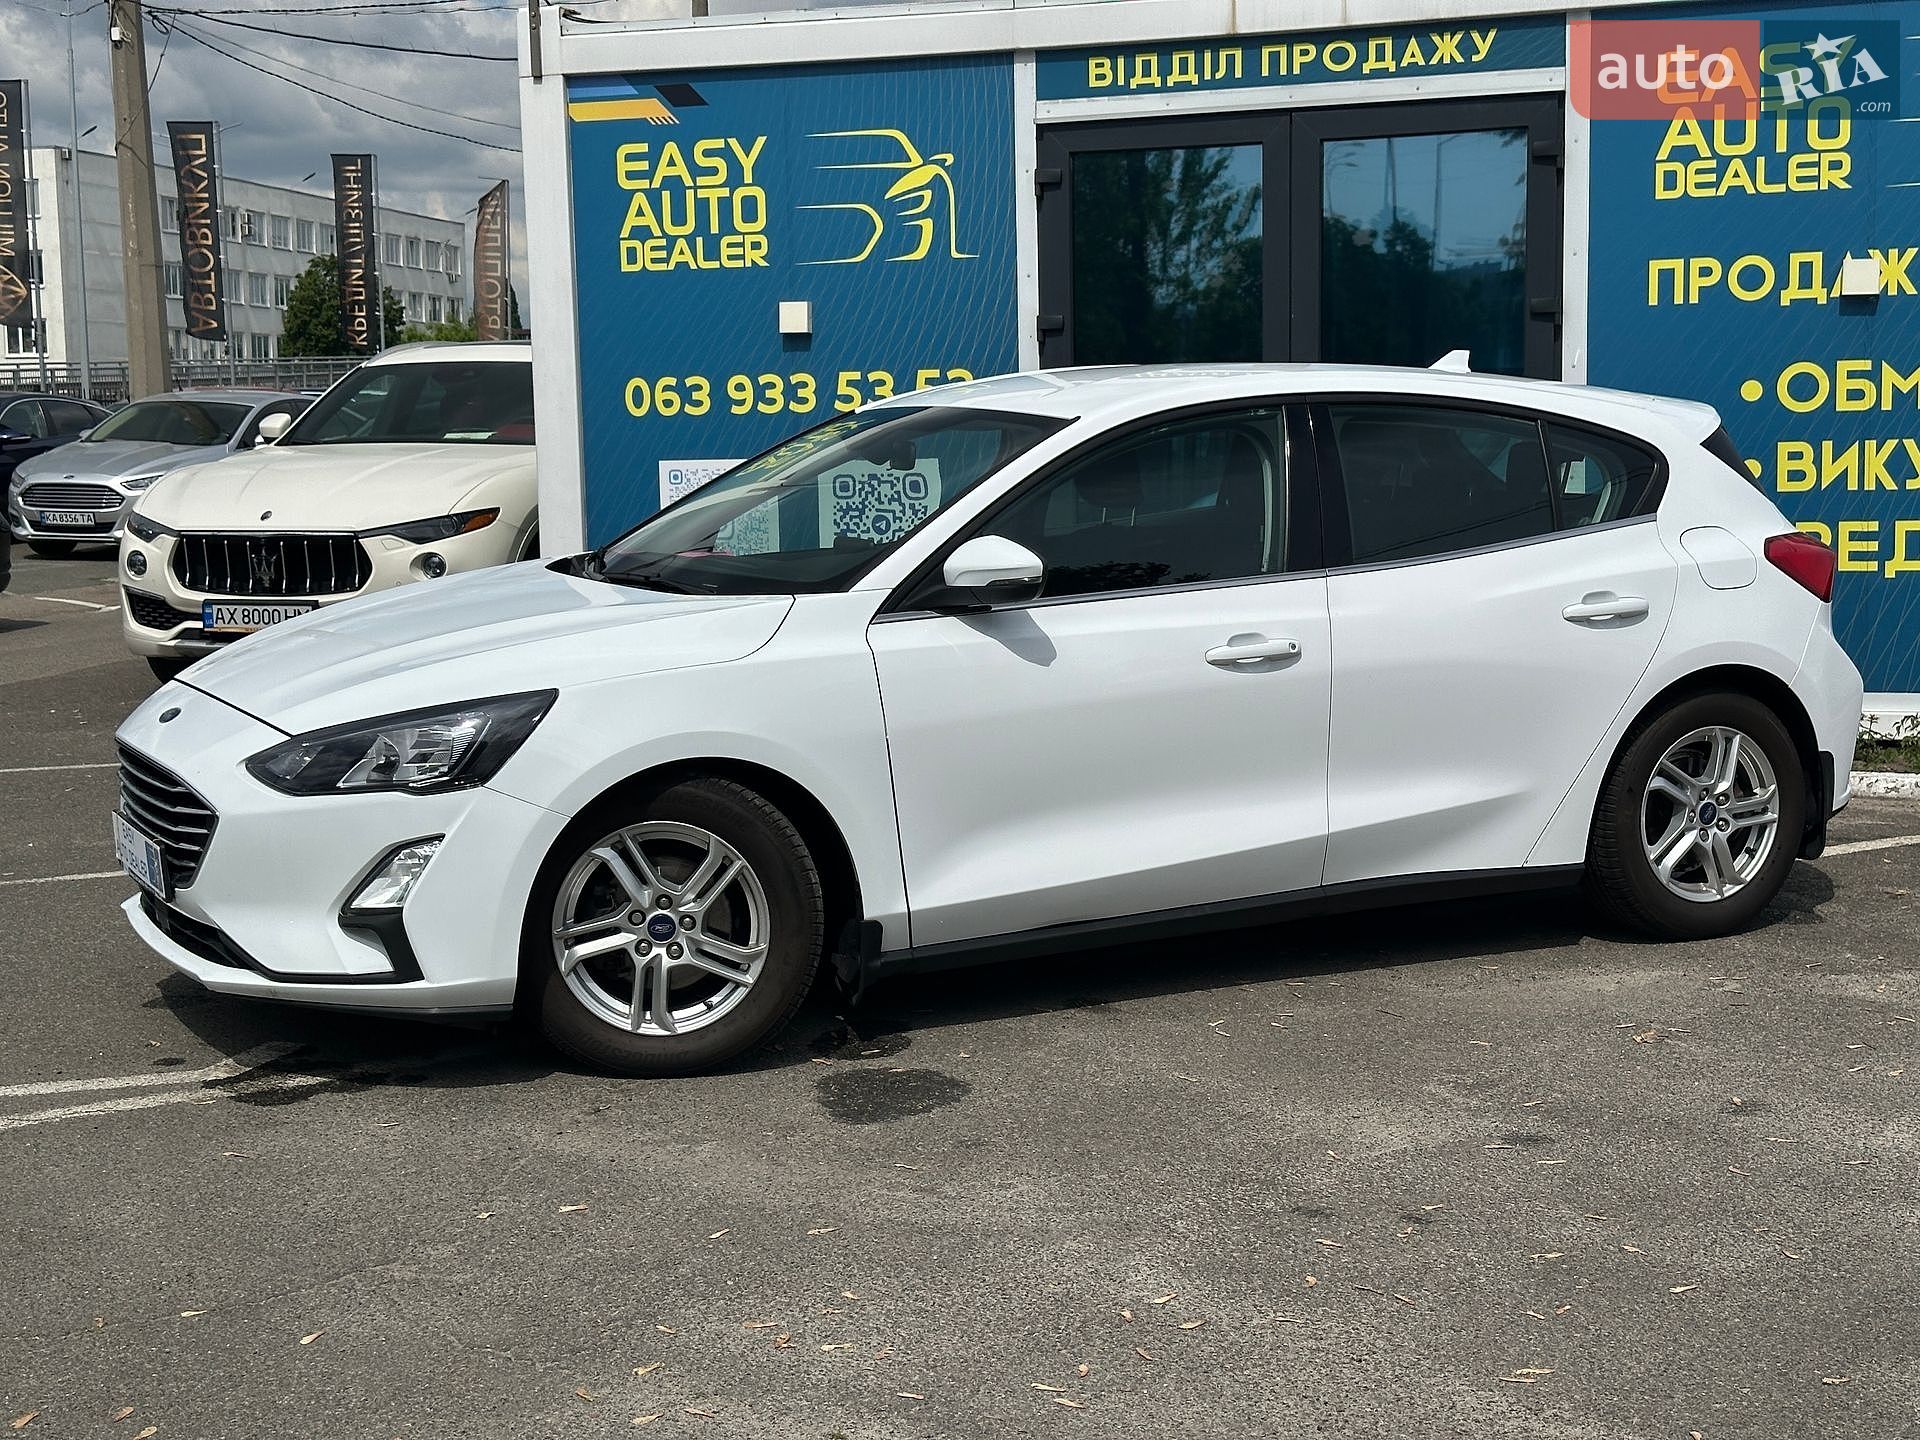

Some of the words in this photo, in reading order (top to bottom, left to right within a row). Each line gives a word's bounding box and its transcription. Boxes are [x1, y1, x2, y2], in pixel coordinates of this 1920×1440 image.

[1088, 47, 1243, 89] ВІДДІЛ
[1261, 28, 1498, 77] ПРОДАЖУ
[1655, 96, 1852, 160] AUTO
[616, 136, 767, 190] EASY
[1655, 152, 1853, 200] DEALER
[620, 187, 767, 239] AUTO
[620, 234, 770, 273] DEALER
[625, 376, 712, 417] 063
[727, 372, 817, 415] 933
[834, 370, 895, 413] 53
[215, 607, 238, 625] AX
[241, 607, 281, 625] 8000
